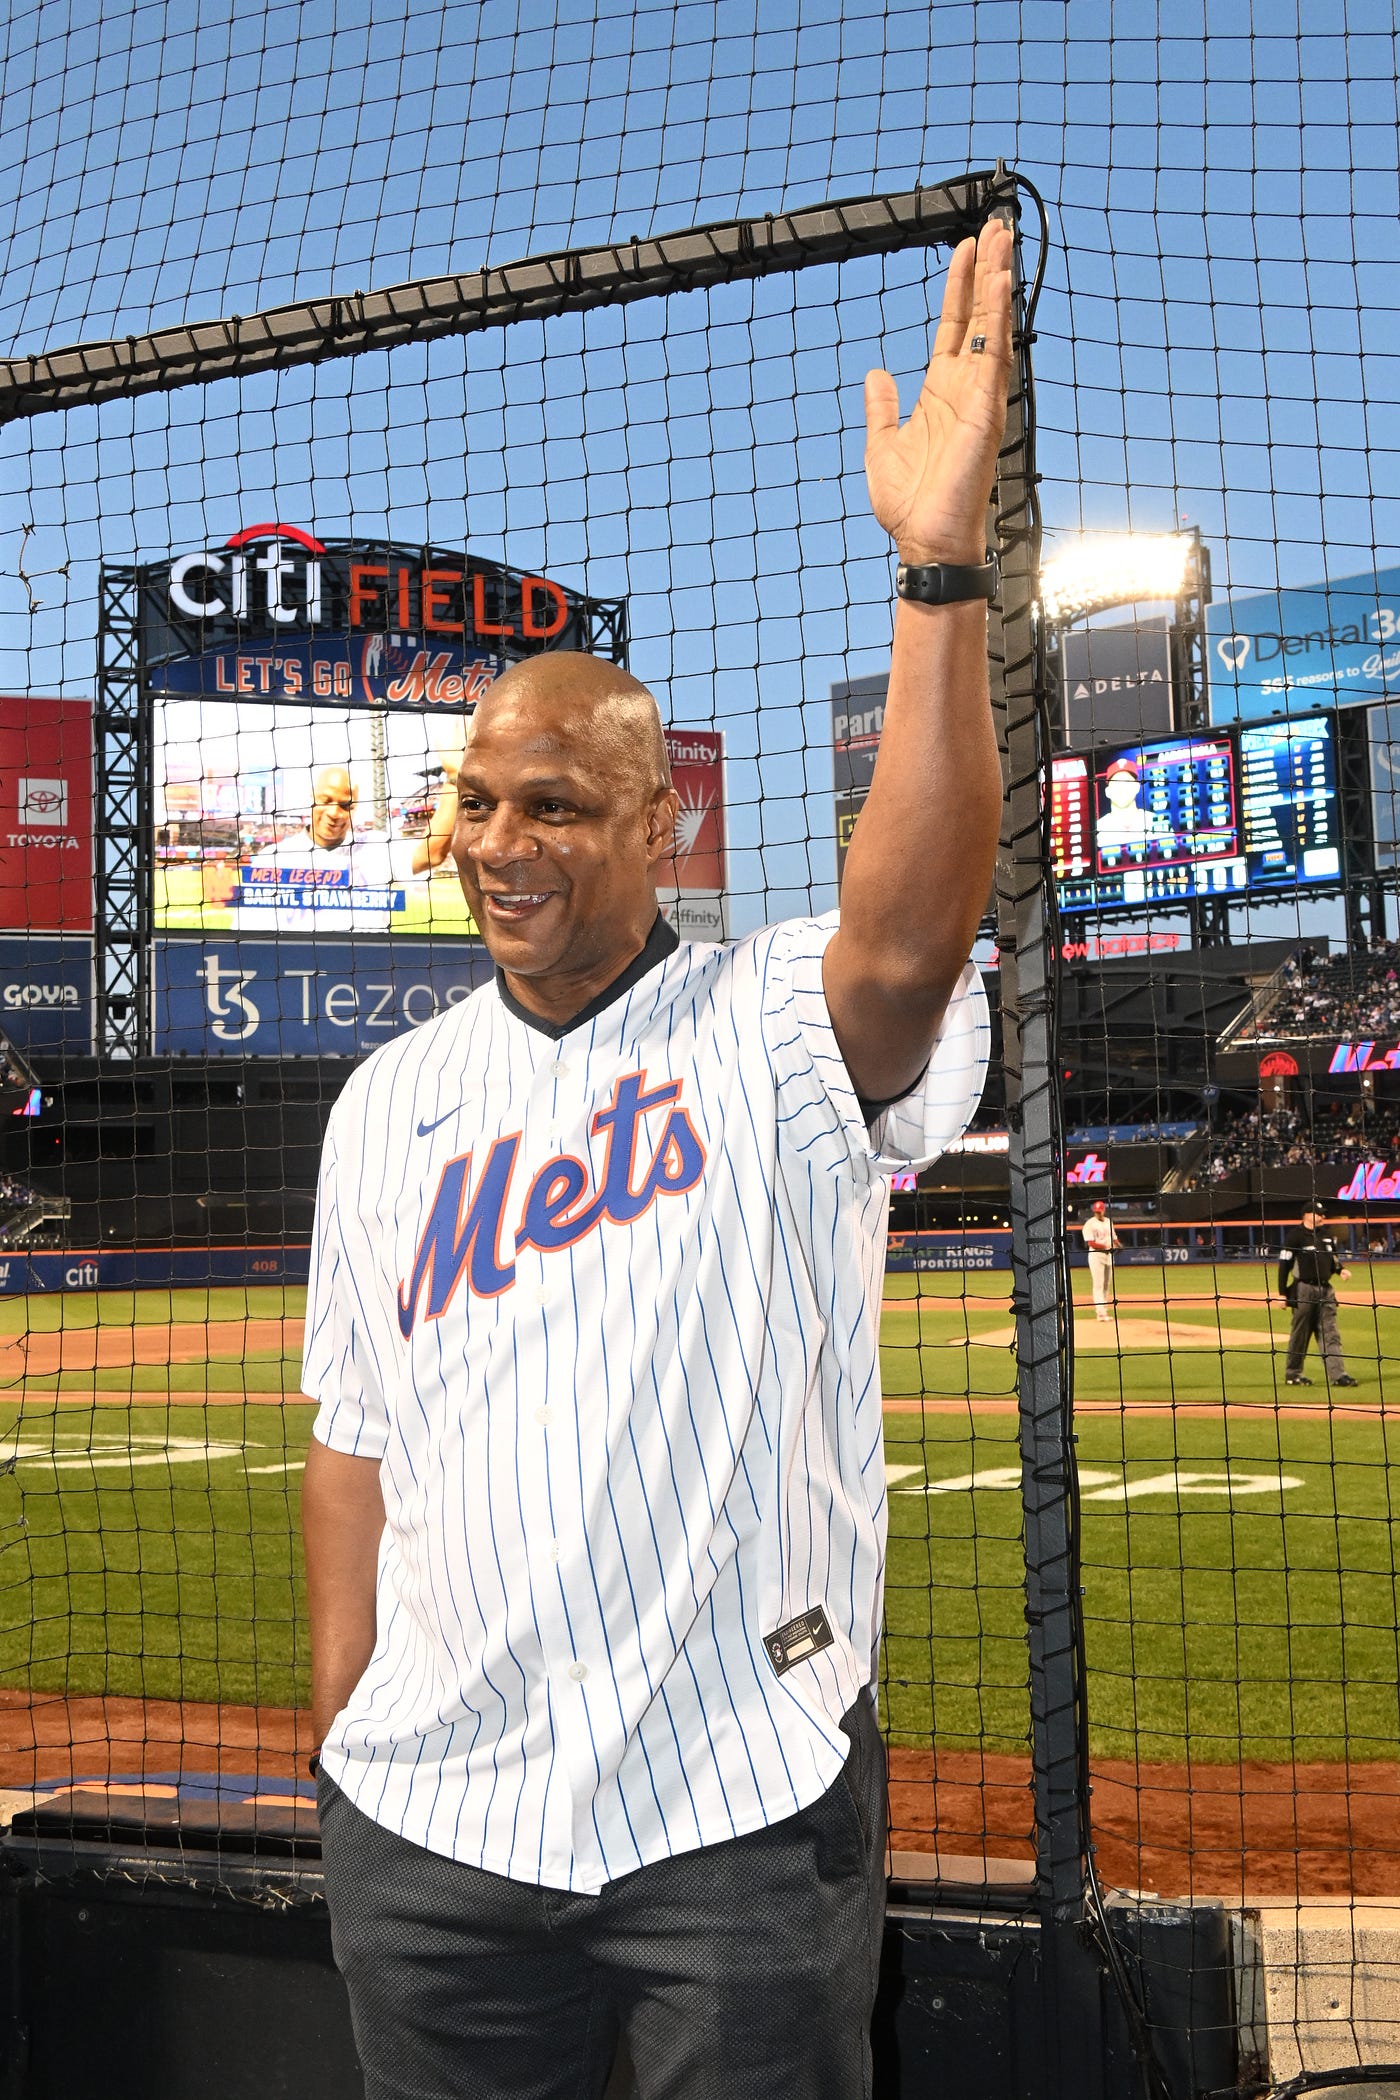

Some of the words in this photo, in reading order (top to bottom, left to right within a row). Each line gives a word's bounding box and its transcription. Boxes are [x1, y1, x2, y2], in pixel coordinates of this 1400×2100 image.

[169, 541, 322, 624] citi
[350, 564, 569, 638] FIELD
[216, 656, 302, 694] LET'S
[313, 660, 353, 697] GO
[1095, 669, 1163, 694] DELTA
[1296, 670, 1345, 686] reasons
[1346, 667, 1360, 678] to
[664, 738, 718, 766] ffinity
[7, 834, 79, 849] TOYOTA
[289, 868, 343, 885] LEGEND
[302, 890, 399, 909] STRAWBERRY
[669, 908, 720, 928] Affinity
[1094, 933, 1180, 957] balance
[3, 984, 79, 1006] GOYA
[397, 1069, 707, 1342] Mets
[913, 1258, 993, 1269] SPORTSBOOK
[1164, 1248, 1189, 1262] 370
[66, 1263, 99, 1286] citi
[252, 1260, 278, 1272] 408
